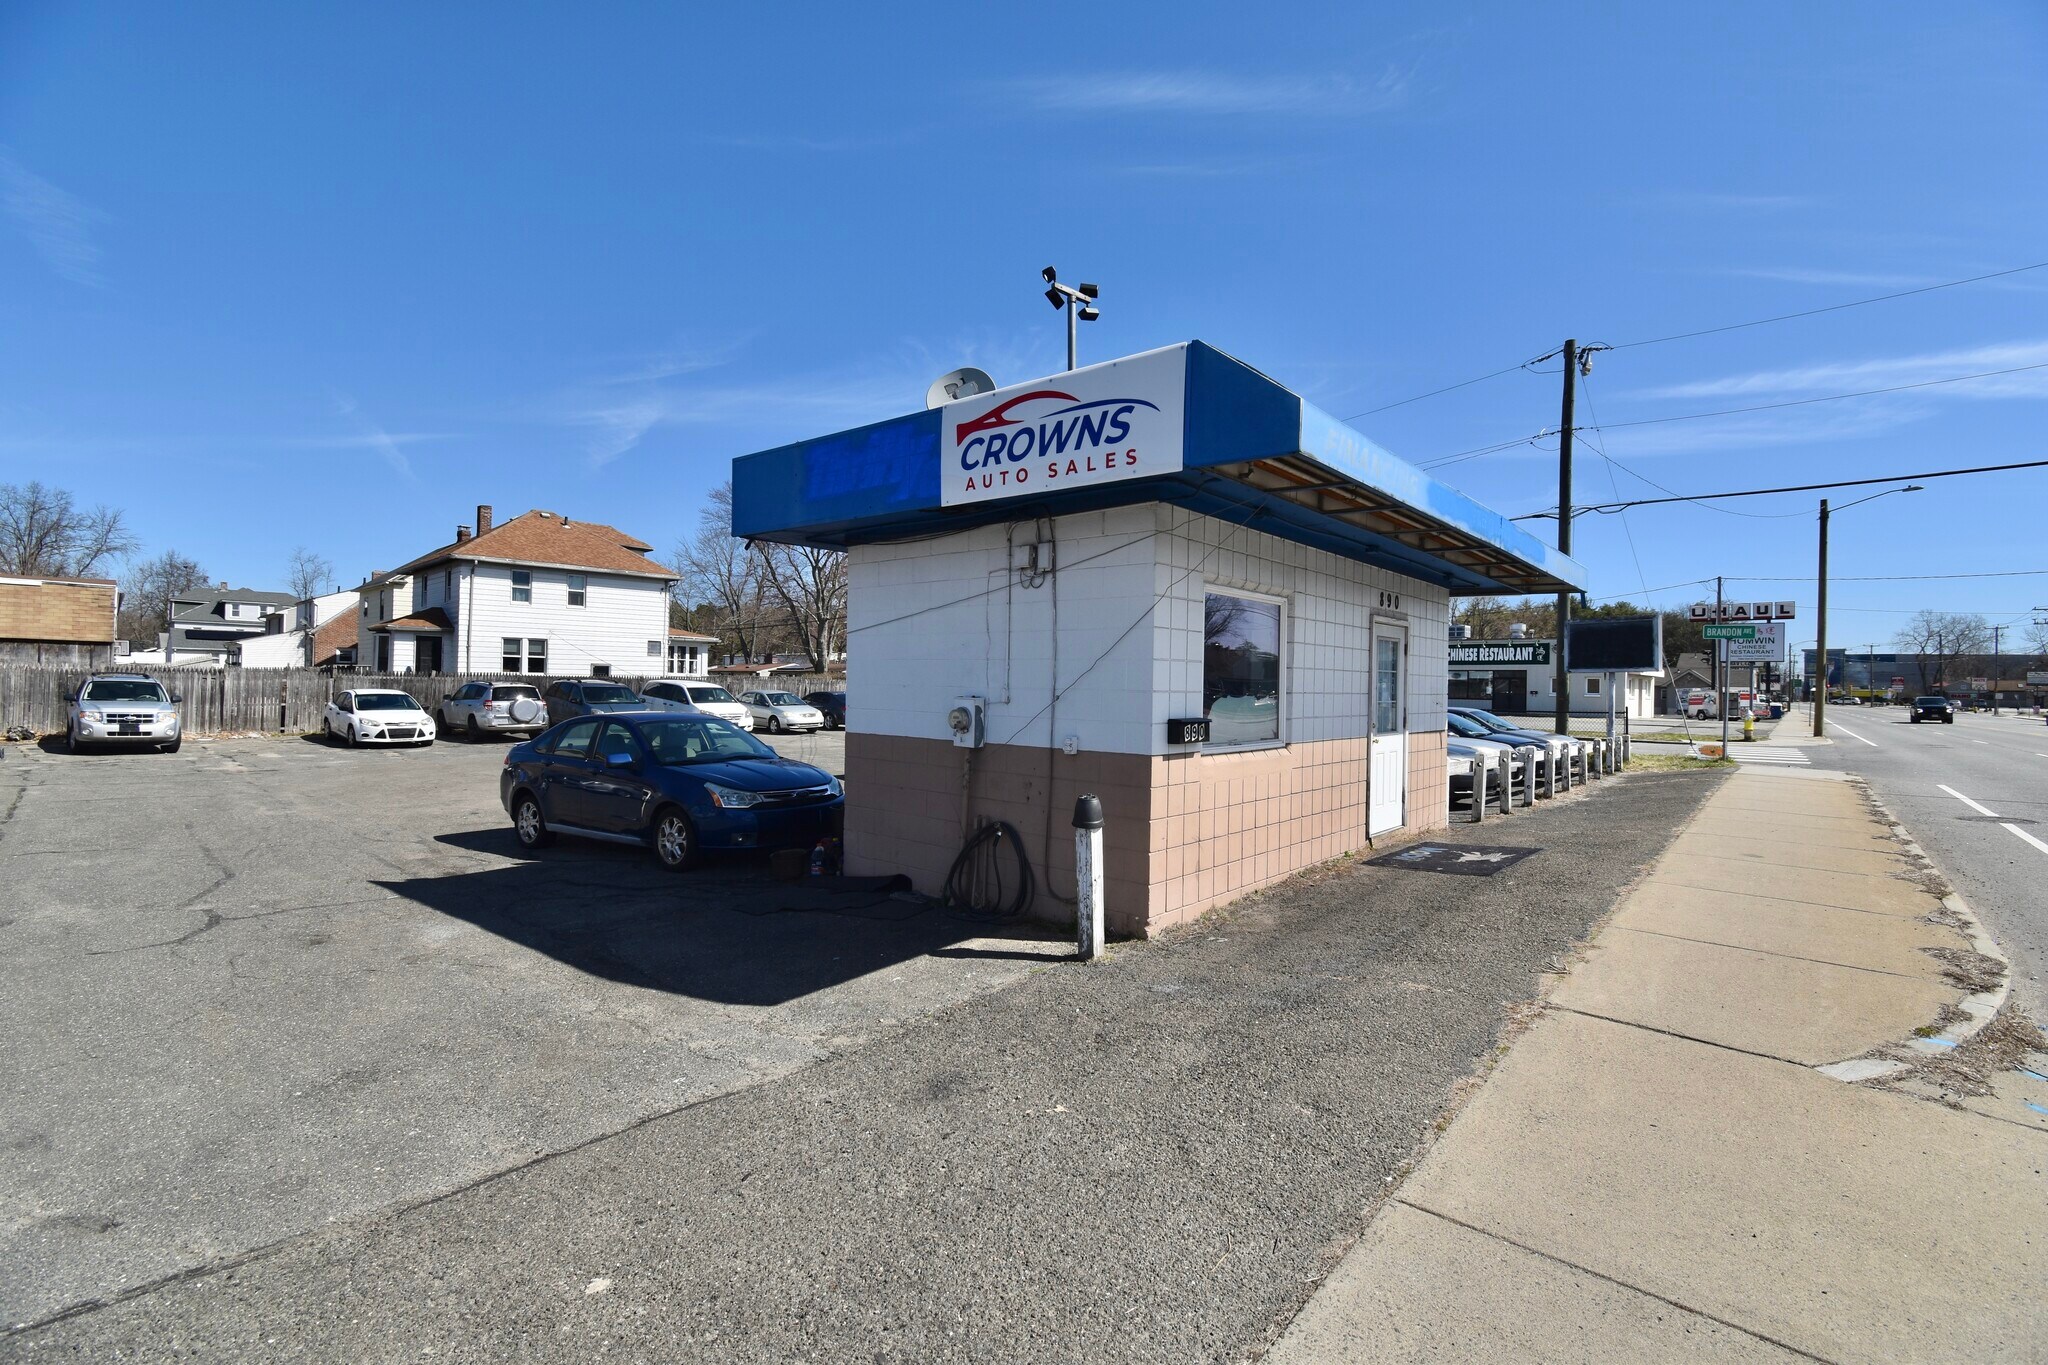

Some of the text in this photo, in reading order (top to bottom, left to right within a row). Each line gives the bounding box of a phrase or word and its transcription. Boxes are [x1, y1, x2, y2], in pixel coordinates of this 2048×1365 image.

[961, 405, 1135, 471] CROWNS
[965, 448, 1138, 492] AUTO SALES
[1379, 591, 1400, 610] 890
[1707, 627, 1742, 636] BRANDON
[1479, 647, 1534, 661] RESTAURANT
[1184, 723, 1205, 743] 890
